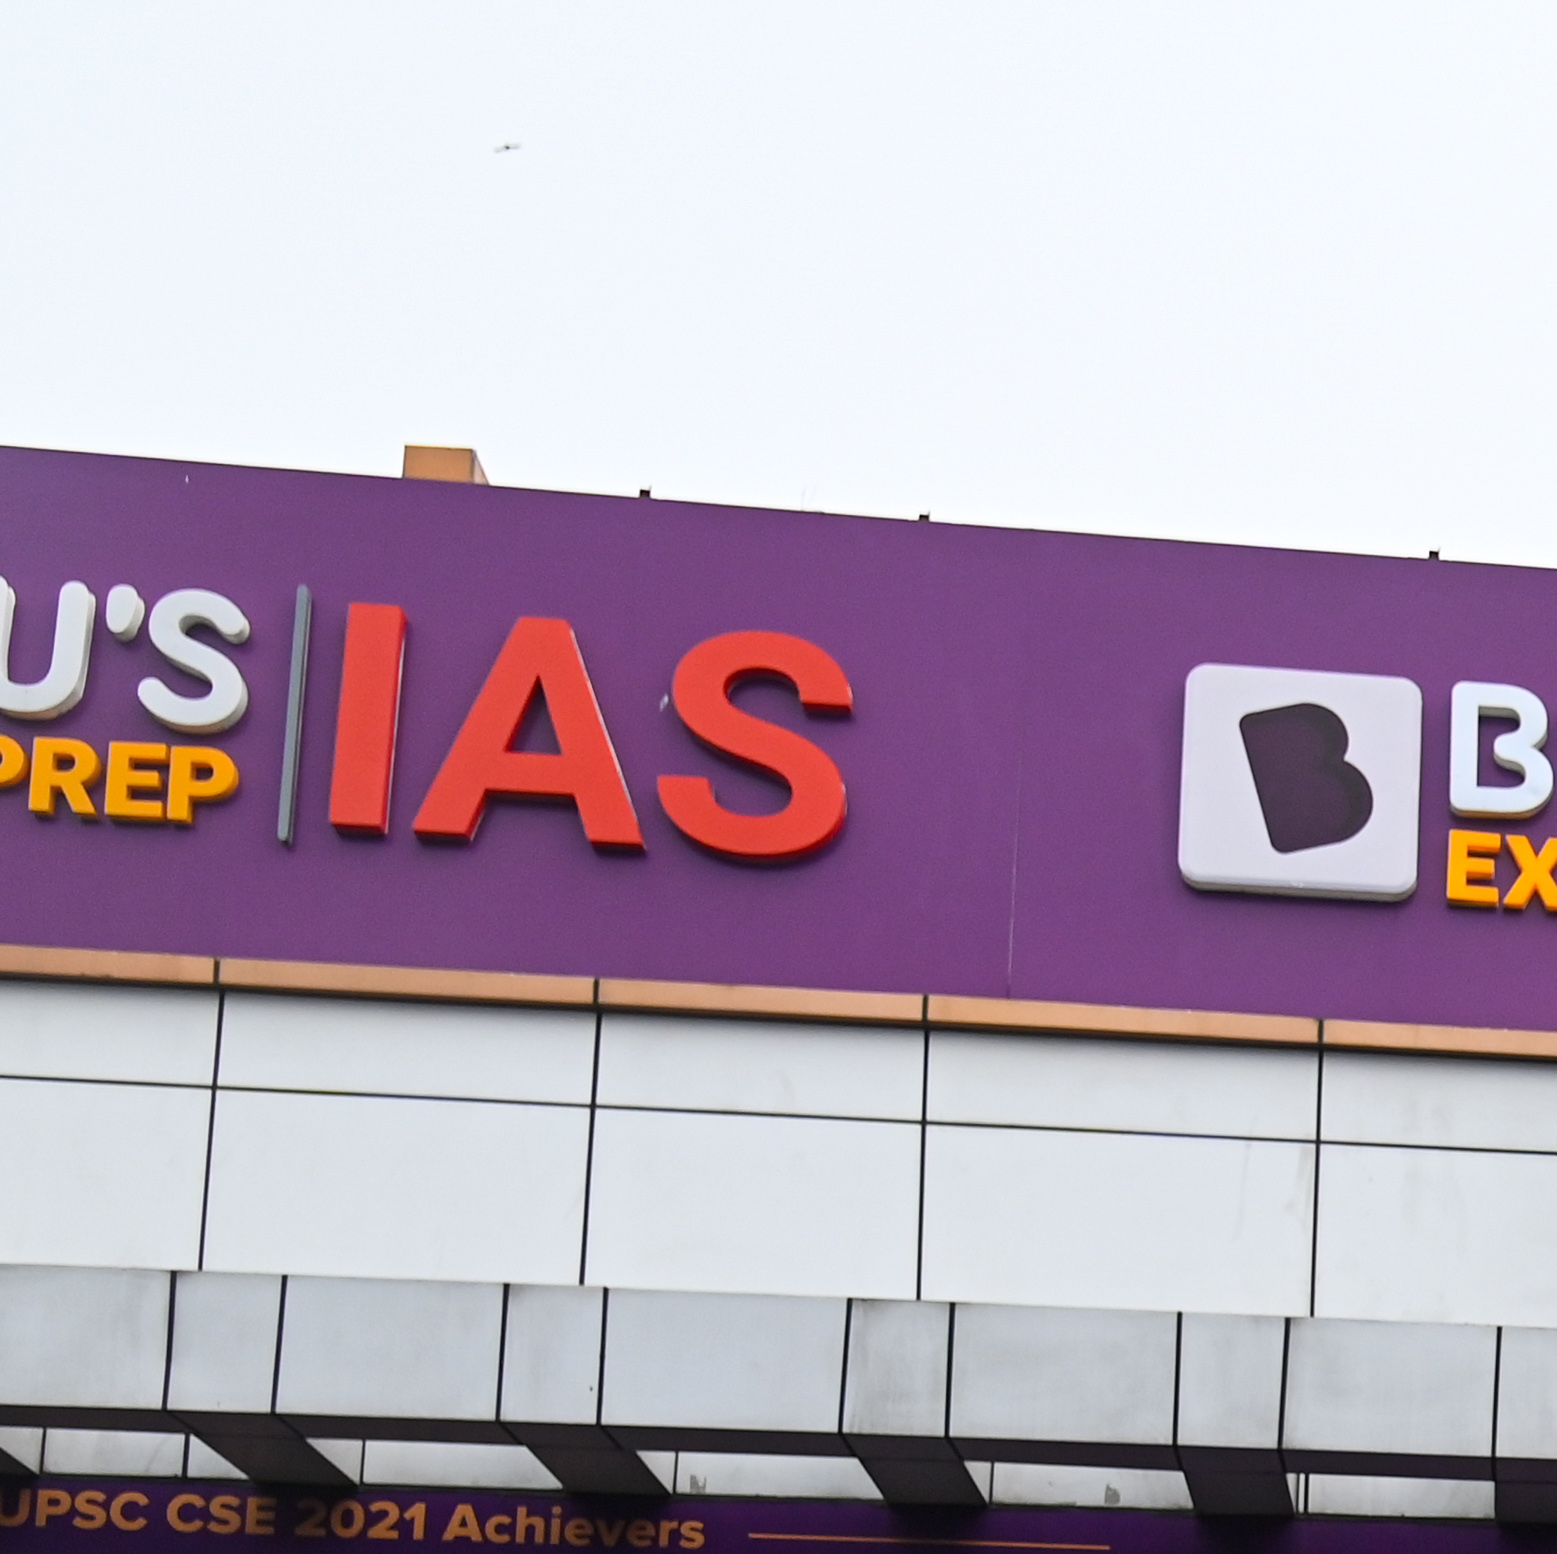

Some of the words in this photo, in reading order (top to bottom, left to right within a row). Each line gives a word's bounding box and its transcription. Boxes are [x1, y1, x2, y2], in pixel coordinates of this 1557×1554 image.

[329, 602, 853, 860] IAS
[0, 1489, 149, 1531] UPSC
[167, 1494, 276, 1534] CSE
[294, 1499, 426, 1540] 2021
[442, 1504, 706, 1549] Achievers
